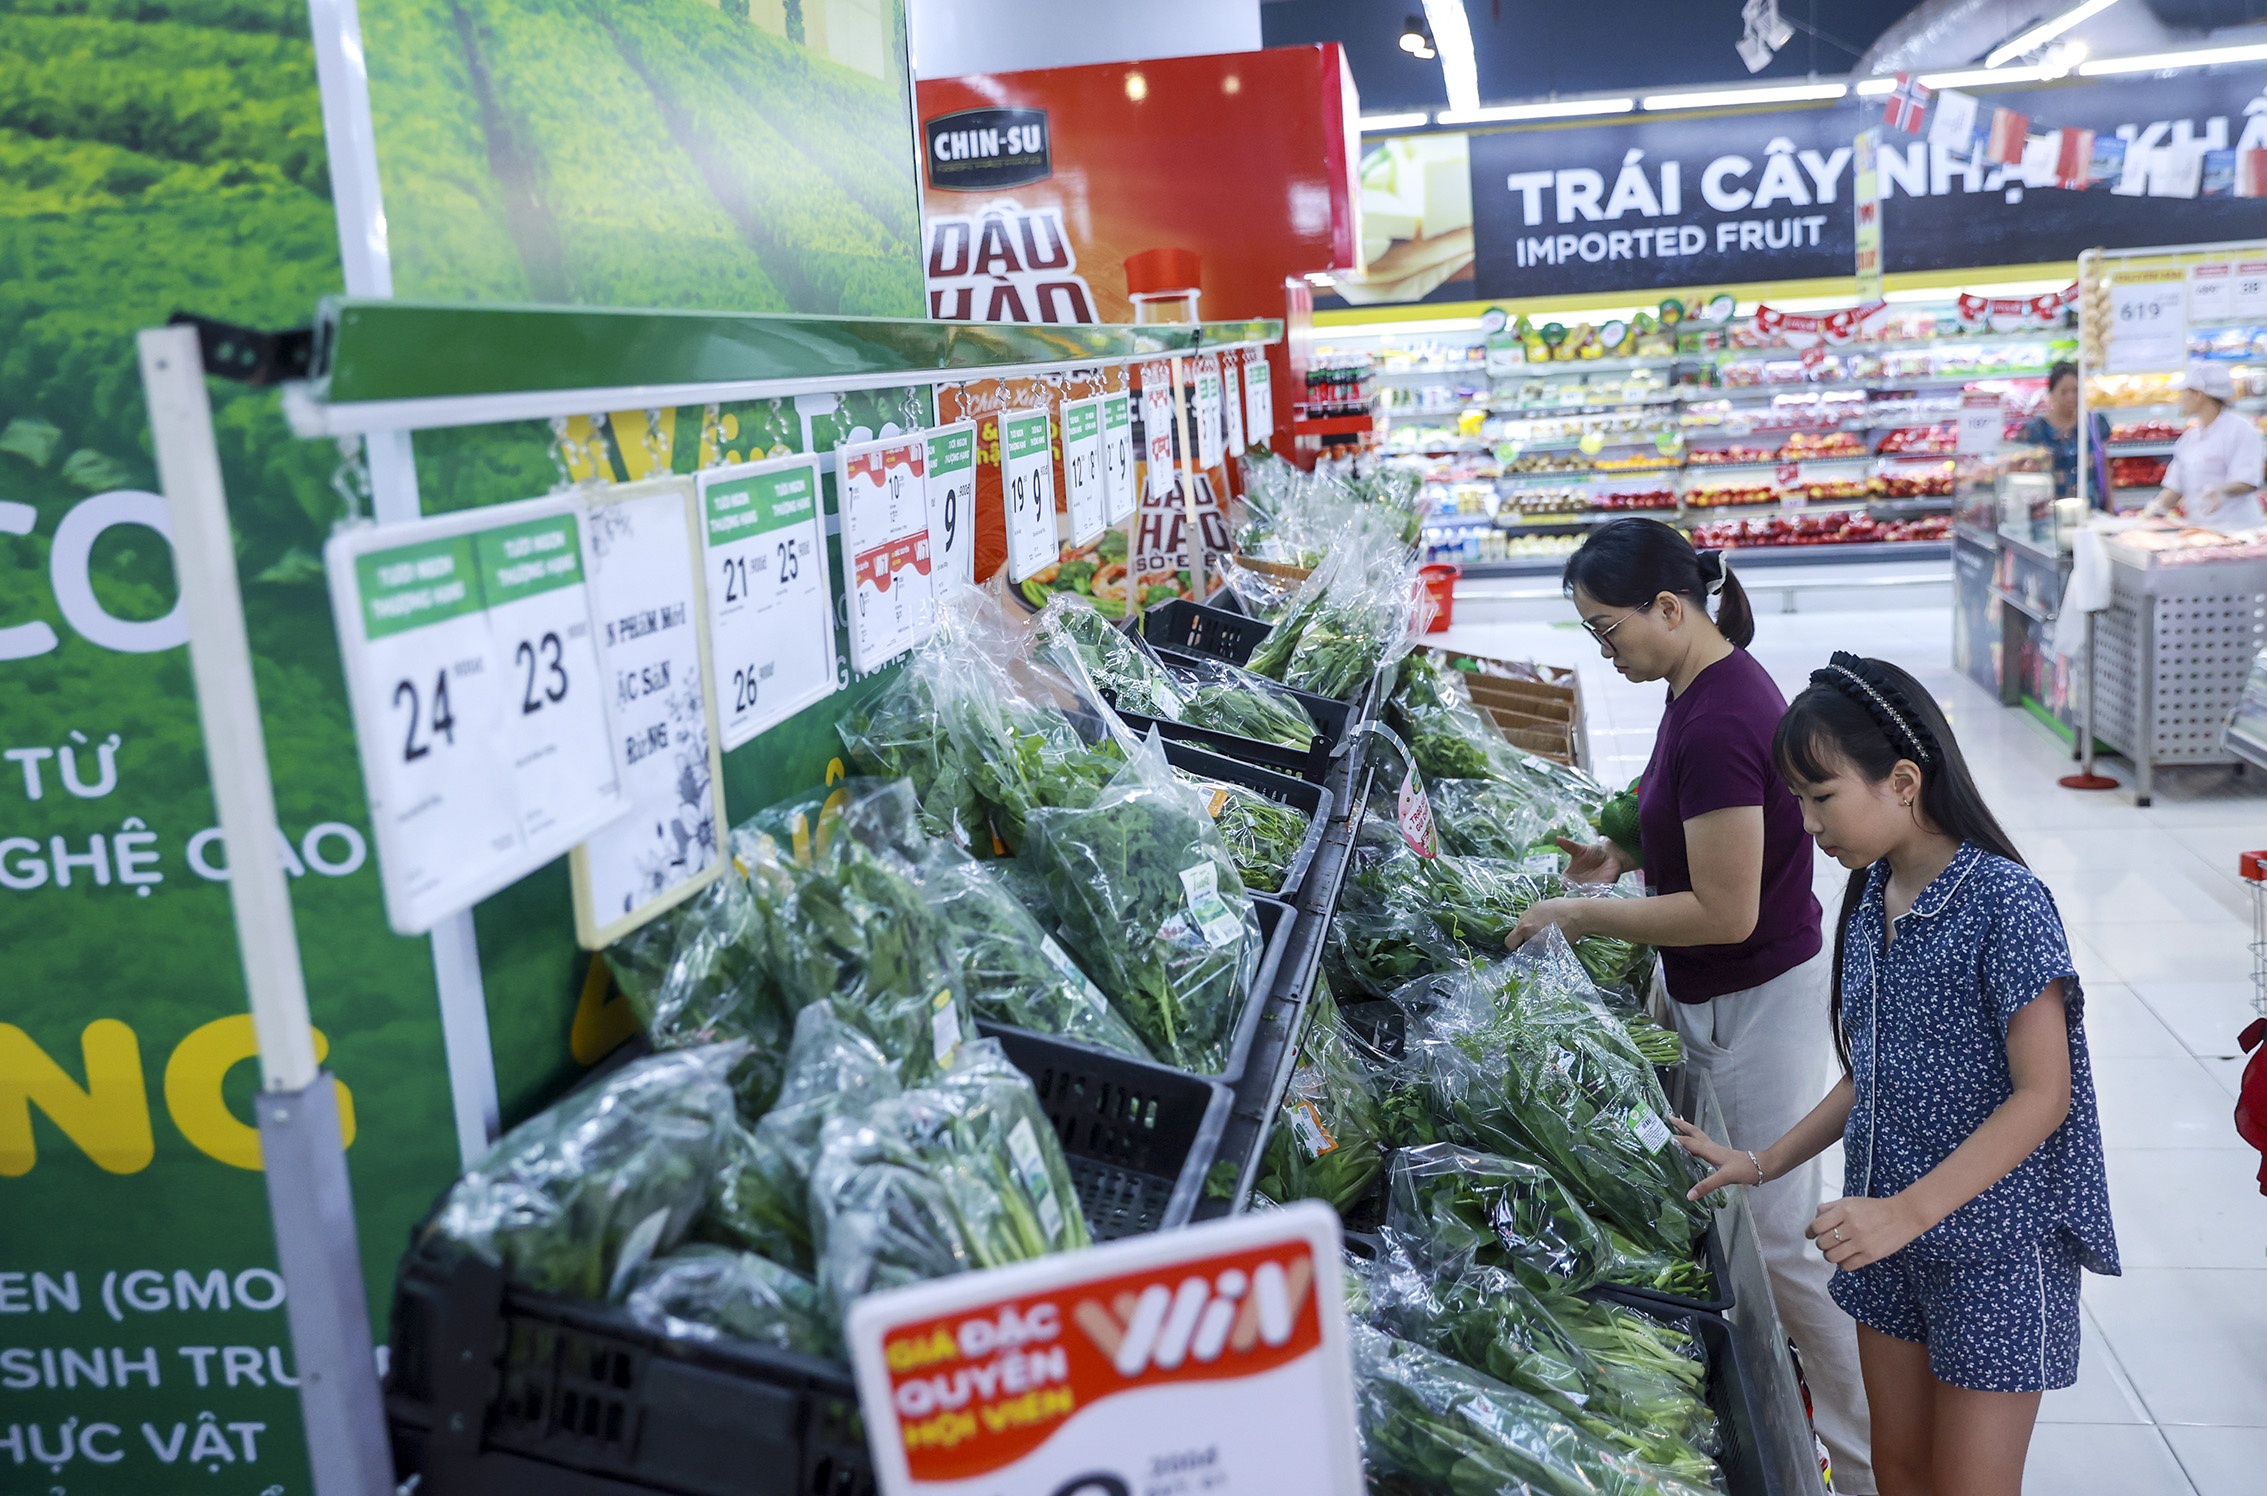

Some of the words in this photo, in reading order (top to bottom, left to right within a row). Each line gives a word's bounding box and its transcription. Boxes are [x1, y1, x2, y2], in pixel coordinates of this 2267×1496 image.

[933, 124, 1042, 161] CHIN-SU
[1507, 146, 1681, 227] TRÁI
[1701, 135, 1853, 213] CÂY
[1515, 225, 1707, 268] IMPORTED
[1716, 215, 1829, 254] FRUIT
[944, 488, 957, 553] 9
[1011, 476, 1025, 514] 19
[1032, 468, 1042, 523] 9
[723, 555, 748, 603] 21
[777, 538, 799, 584] 25
[516, 631, 569, 716] 23
[734, 663, 758, 713] 26
[392, 667, 456, 764] 24
[3, 729, 121, 800] TỪ
[0, 1012, 357, 1178] NG
[102, 1267, 287, 1322] (GMO
[1, 1346, 161, 1389] SINH
[141, 1411, 267, 1473] VẬT
